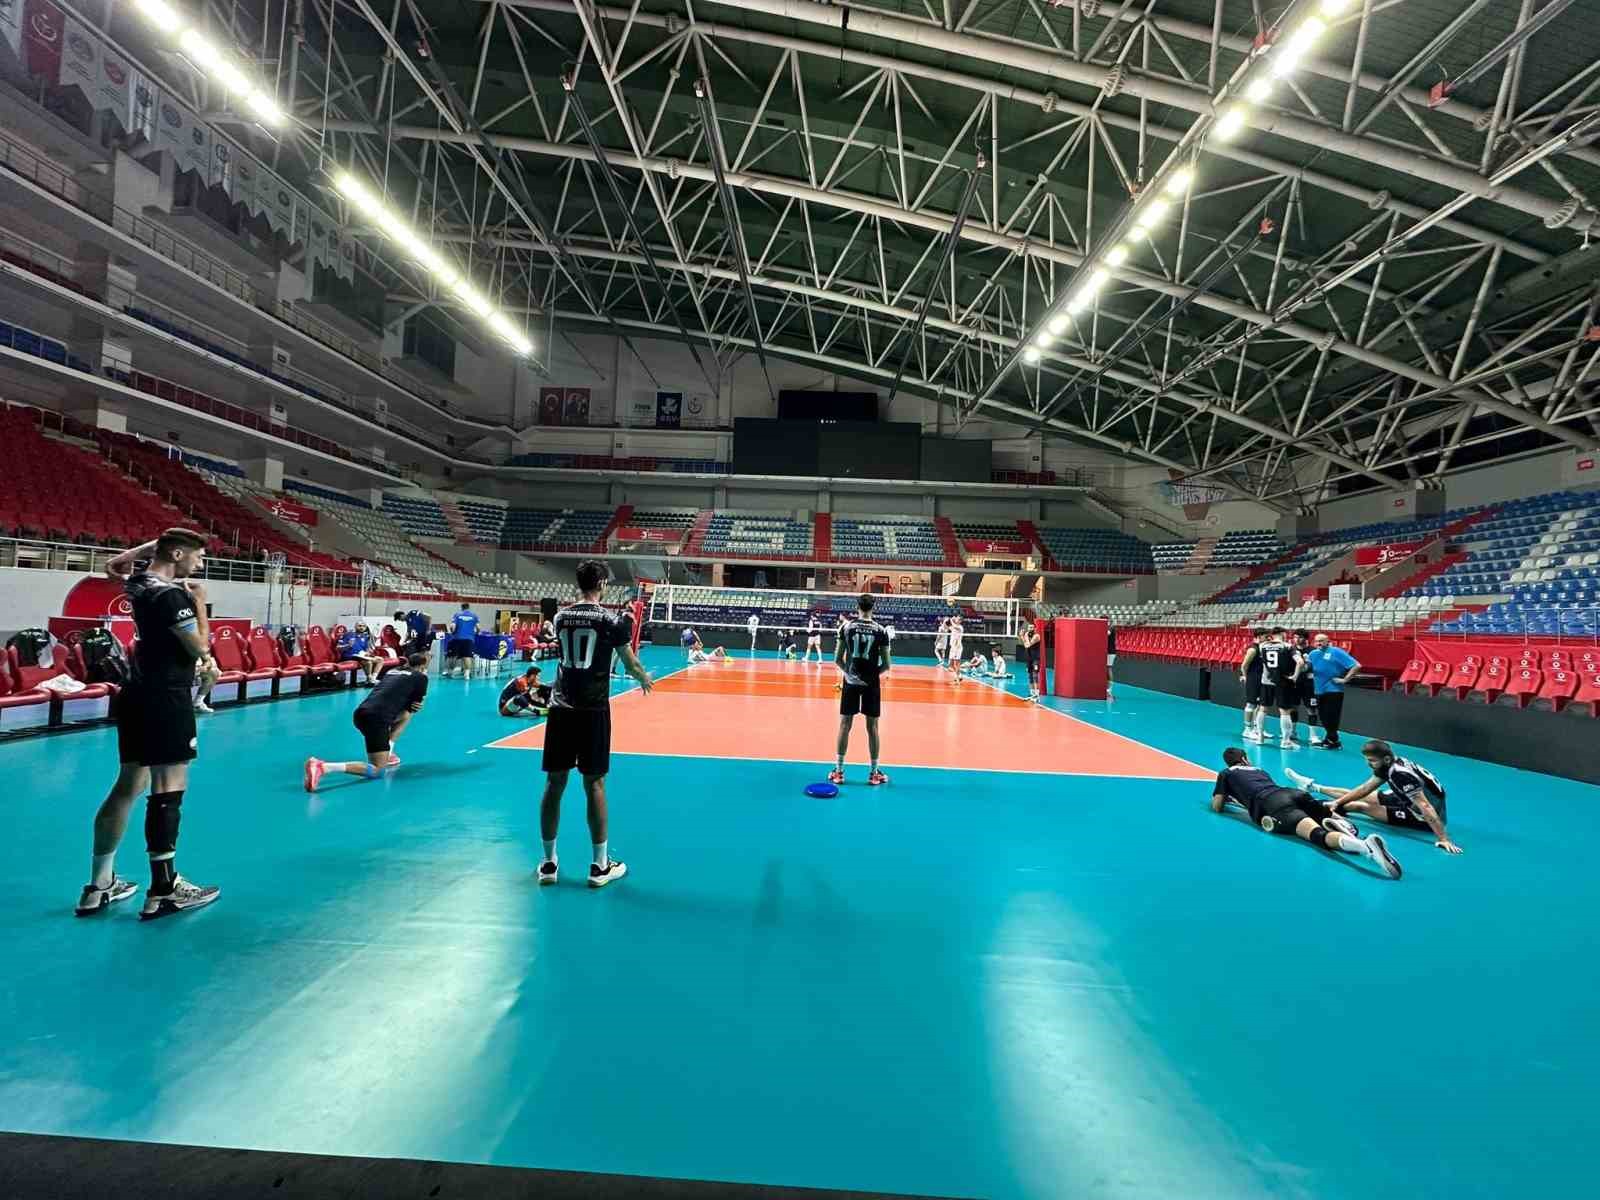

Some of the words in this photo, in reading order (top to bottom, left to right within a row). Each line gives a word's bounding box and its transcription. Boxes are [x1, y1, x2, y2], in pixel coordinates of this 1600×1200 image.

[559, 628, 597, 669] 10
[852, 633, 875, 660] 17
[1265, 650, 1279, 668] 9
